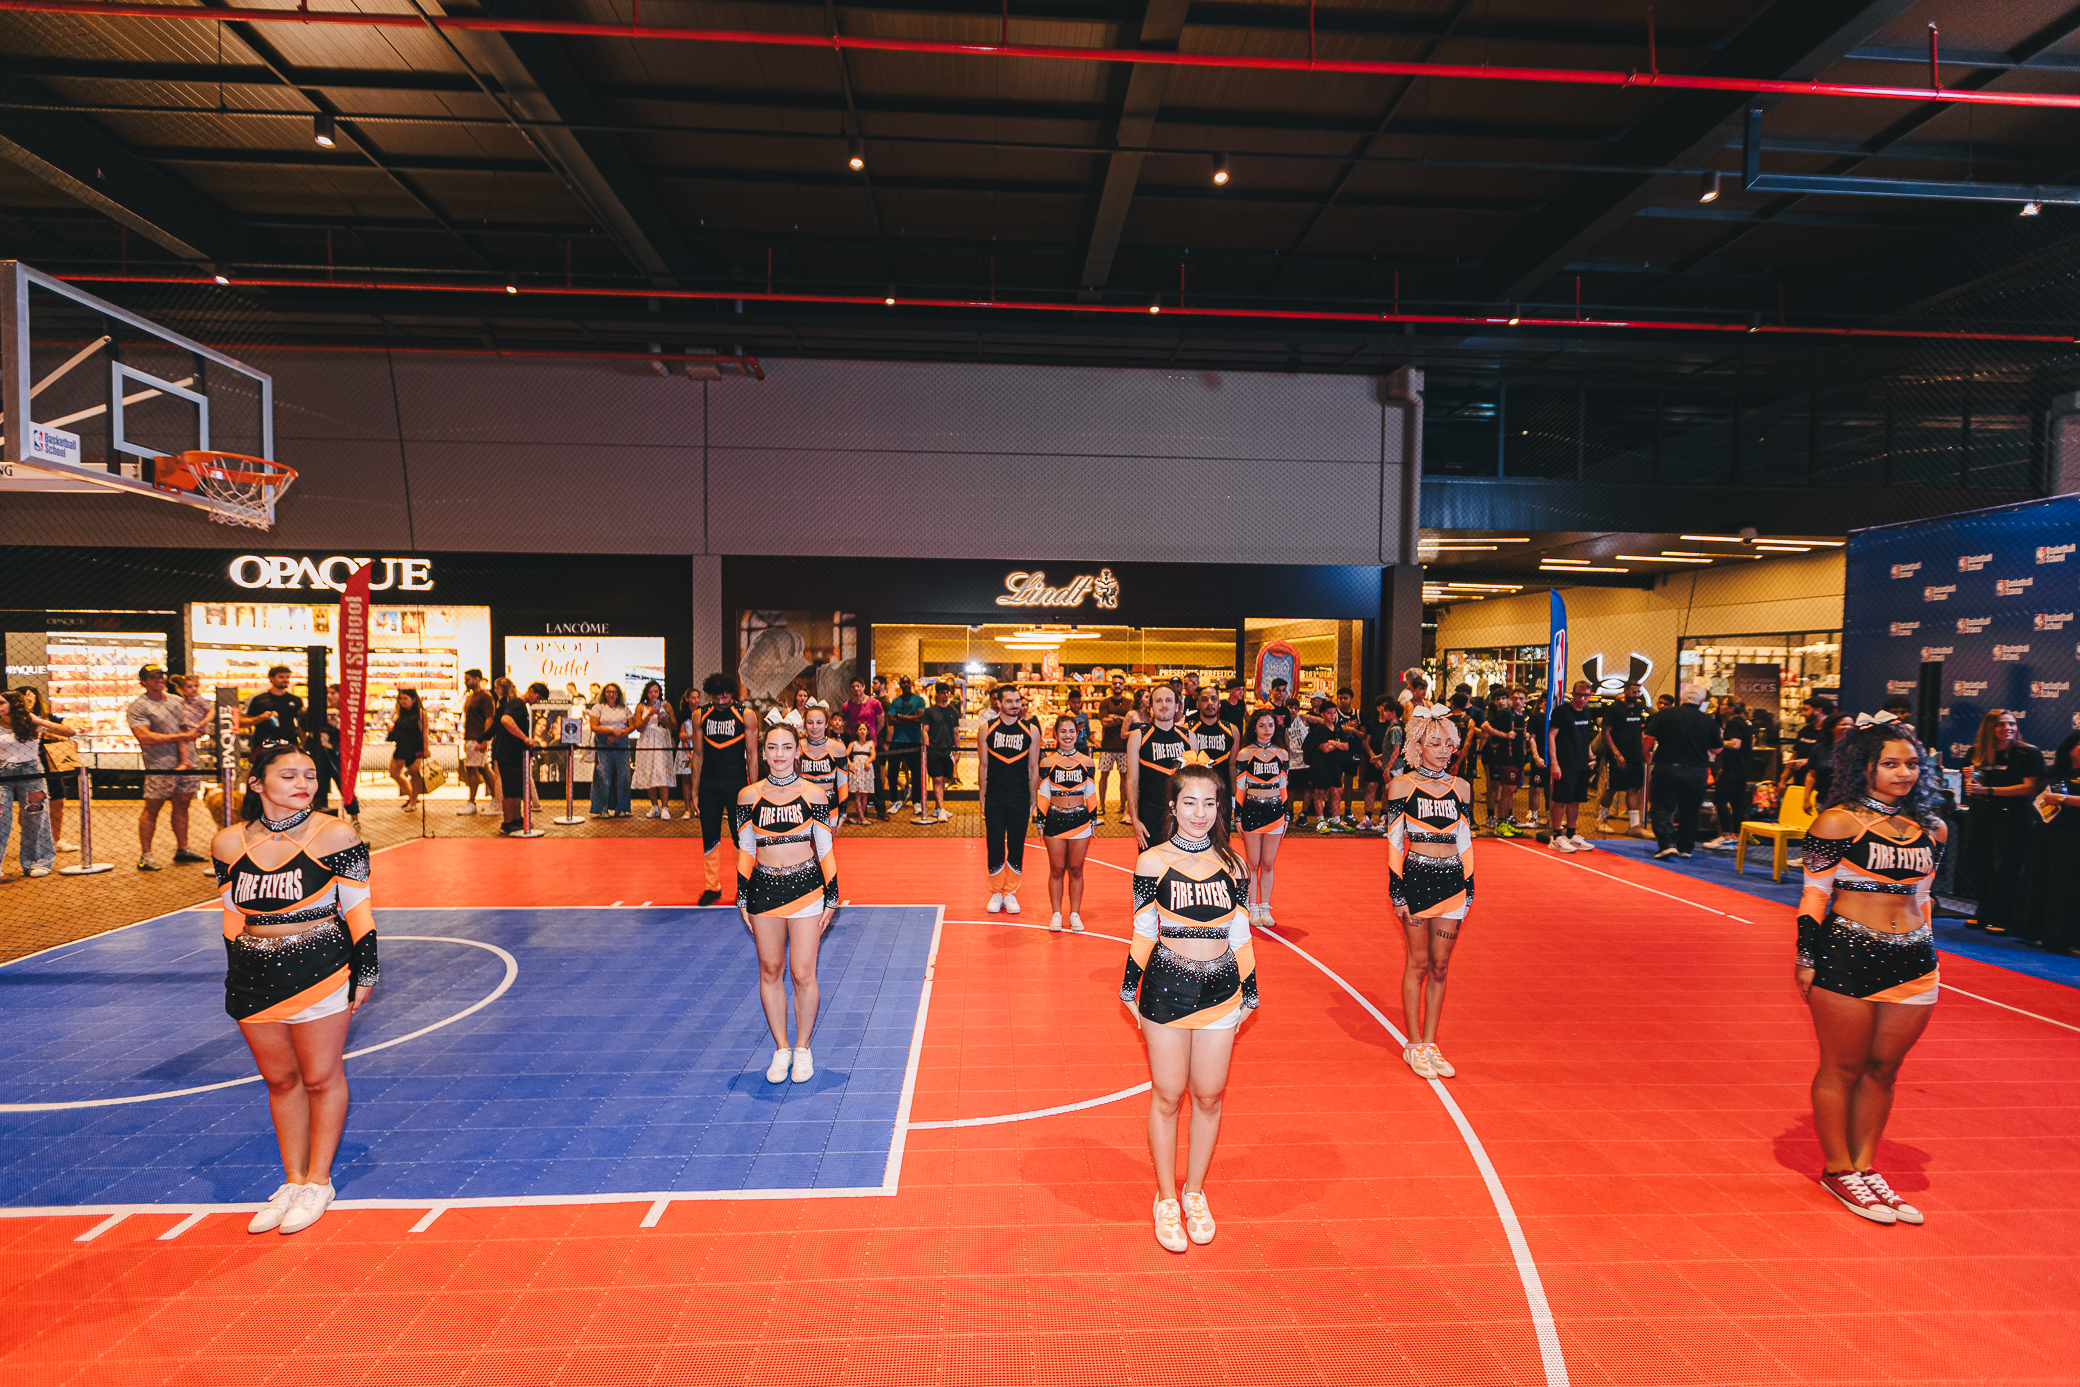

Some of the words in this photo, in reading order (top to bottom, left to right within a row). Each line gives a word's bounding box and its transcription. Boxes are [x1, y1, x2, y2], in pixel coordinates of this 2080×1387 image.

[45, 432, 76, 450] Basketball
[45, 443, 66, 458] School
[229, 555, 434, 593] OPAQUE
[996, 571, 1093, 607] Lindt
[345, 596, 364, 665] School
[546, 621, 609, 634] LANCÔME
[6, 665, 47, 675] PAQUE
[541, 657, 589, 676] Outlet
[1740, 683, 1777, 693] KICKS
[706, 718, 717, 736] FIRE
[718, 718, 736, 737] FLYERS
[994, 731, 1005, 749] FIRE
[1006, 733, 1024, 751] FLYERS
[1197, 733, 1208, 749] FIRE
[1208, 733, 1226, 751] FLYERS
[1152, 741, 1165, 761] FIRE
[801, 759, 812, 773] FIRE
[813, 758, 831, 773] FLYERS
[1253, 761, 1264, 775] FIRE
[1264, 761, 1280, 775] FLYERS
[1054, 769, 1066, 784] FIRE
[1066, 769, 1083, 783] FLYERS
[758, 806, 775, 827] FIRE
[776, 803, 804, 824] FLYERS
[1417, 797, 1434, 819] FIRE
[1434, 798, 1458, 820] FLYERS
[1866, 842, 1896, 869] FIRE
[1896, 846, 1934, 875] FLYERS
[234, 871, 261, 904] FIRE
[259, 868, 304, 900] FLYERS
[1170, 880, 1194, 911] FIRE
[1195, 880, 1232, 910] FLYERS
